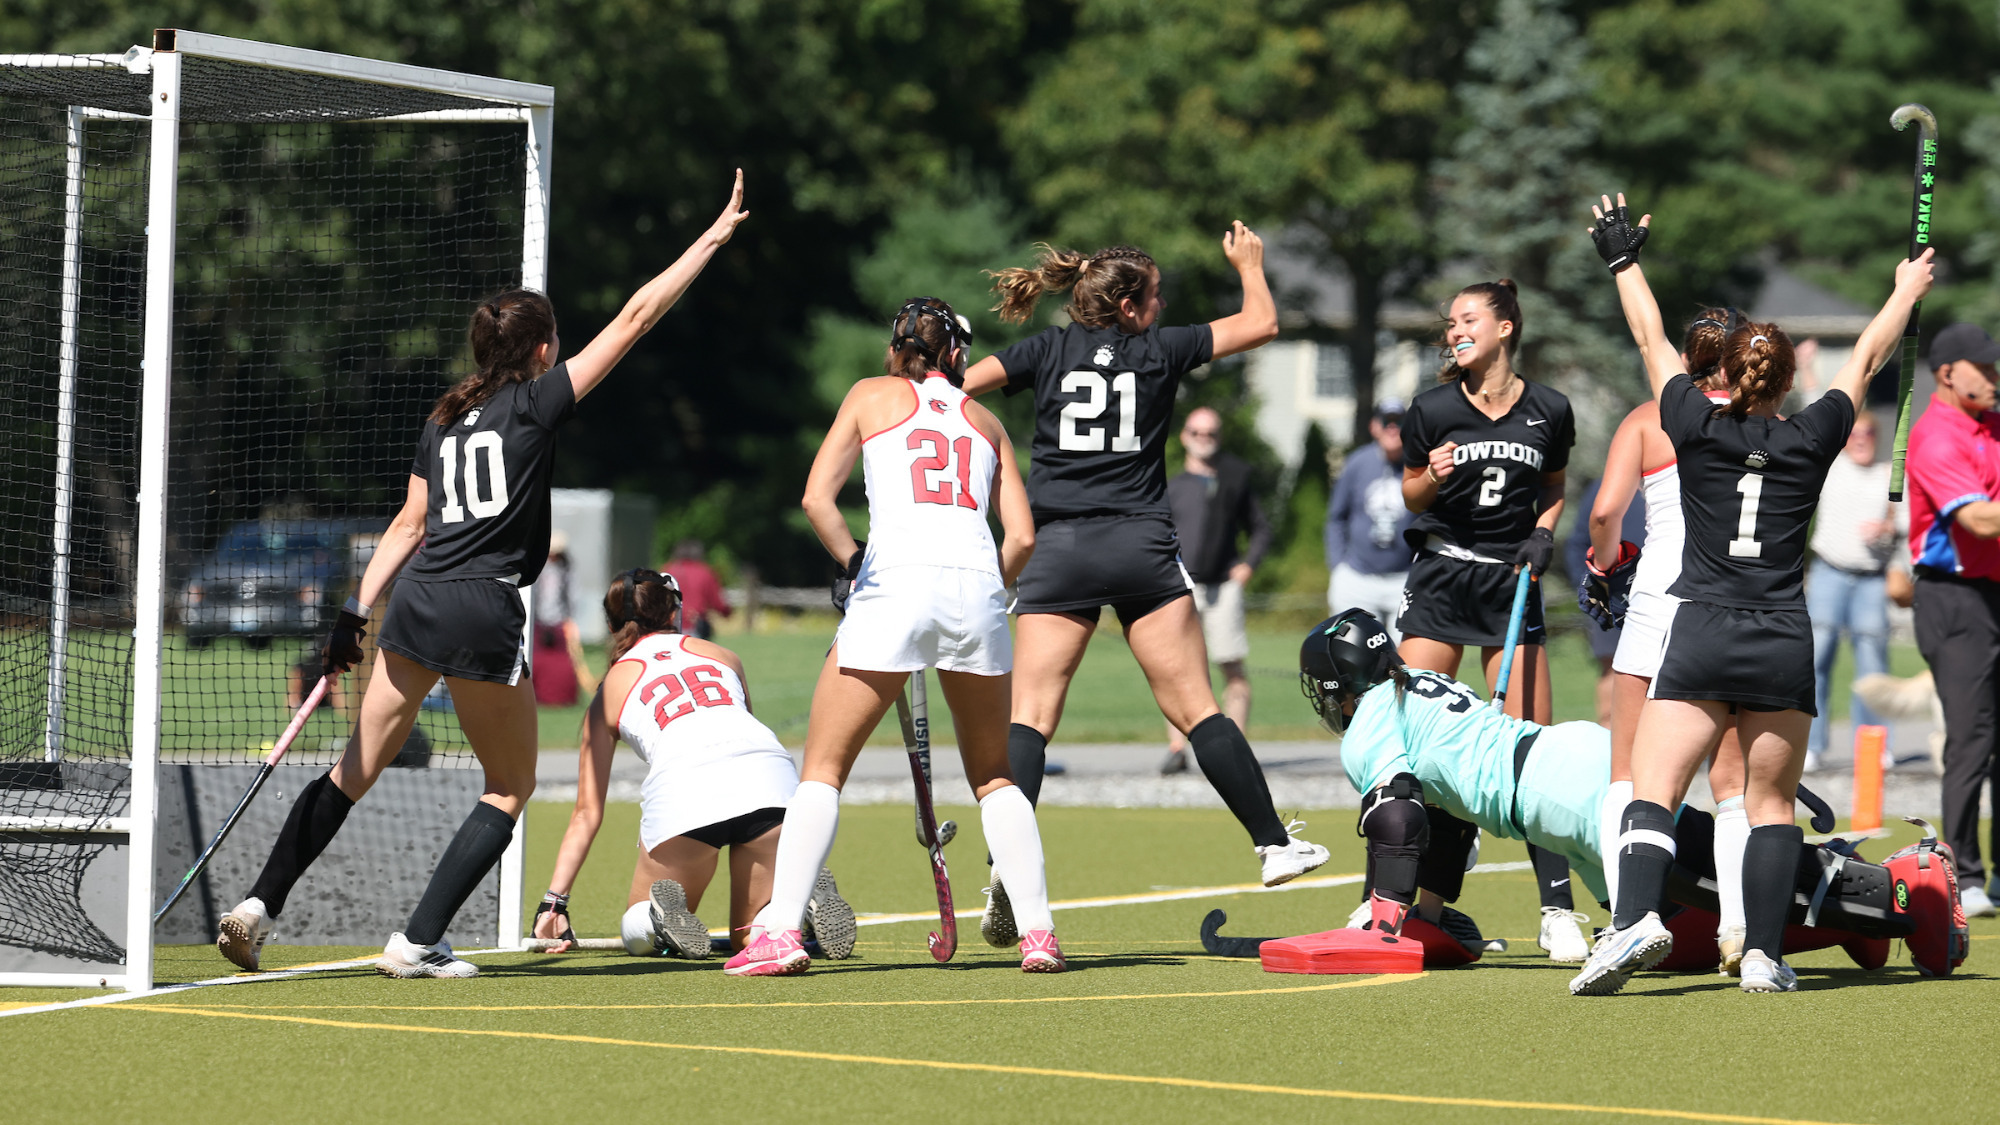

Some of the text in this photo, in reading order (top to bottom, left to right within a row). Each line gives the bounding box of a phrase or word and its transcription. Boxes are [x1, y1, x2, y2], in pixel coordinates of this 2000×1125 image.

[1922, 139, 1937, 168] 世界
[1916, 193, 1933, 244] OSAKA
[1059, 371, 1142, 452] 21
[439, 430, 510, 523] 10
[906, 428, 978, 511] 21
[1452, 440, 1544, 472] OWDOIN
[1478, 466, 1507, 506] 2
[1728, 472, 1764, 558] 1
[1366, 632, 1388, 649] OBO
[640, 664, 735, 731] 26
[915, 717, 931, 770] OSAKA
